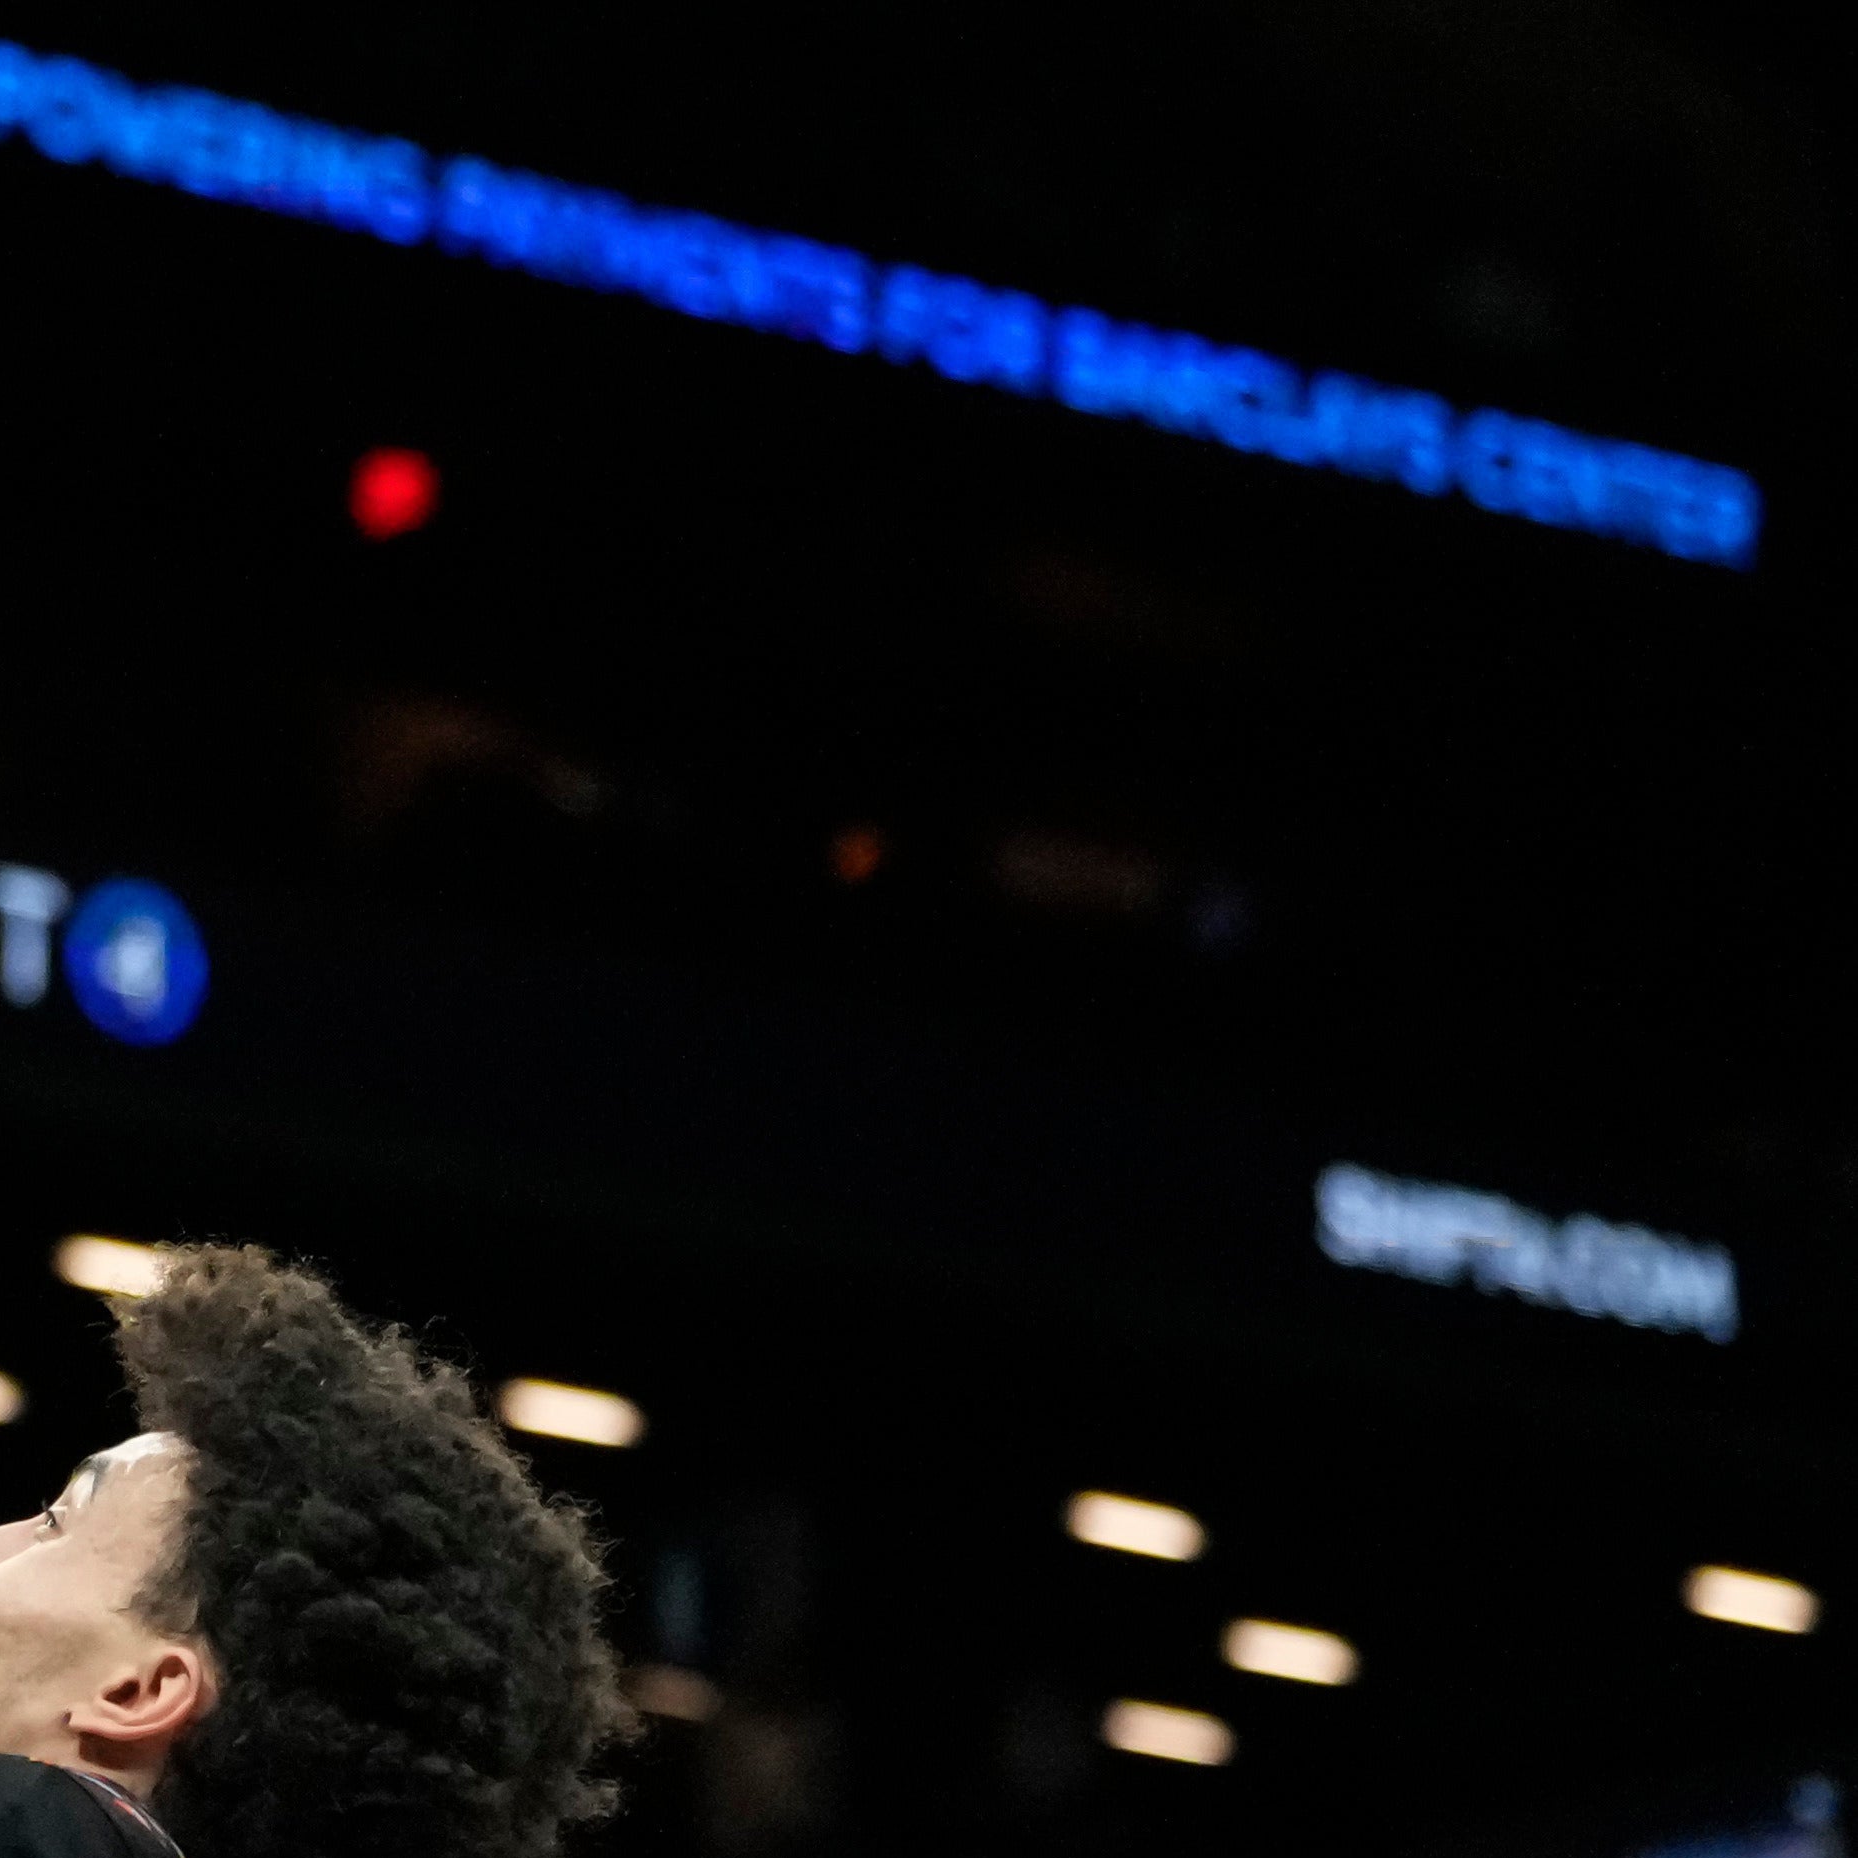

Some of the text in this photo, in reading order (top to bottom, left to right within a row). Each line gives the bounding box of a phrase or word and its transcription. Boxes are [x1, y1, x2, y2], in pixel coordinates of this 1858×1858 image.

[882, 263, 1044, 391] FOR
[1057, 306, 1451, 496] BARCLAYS
[1463, 410, 1761, 570] CENTER
